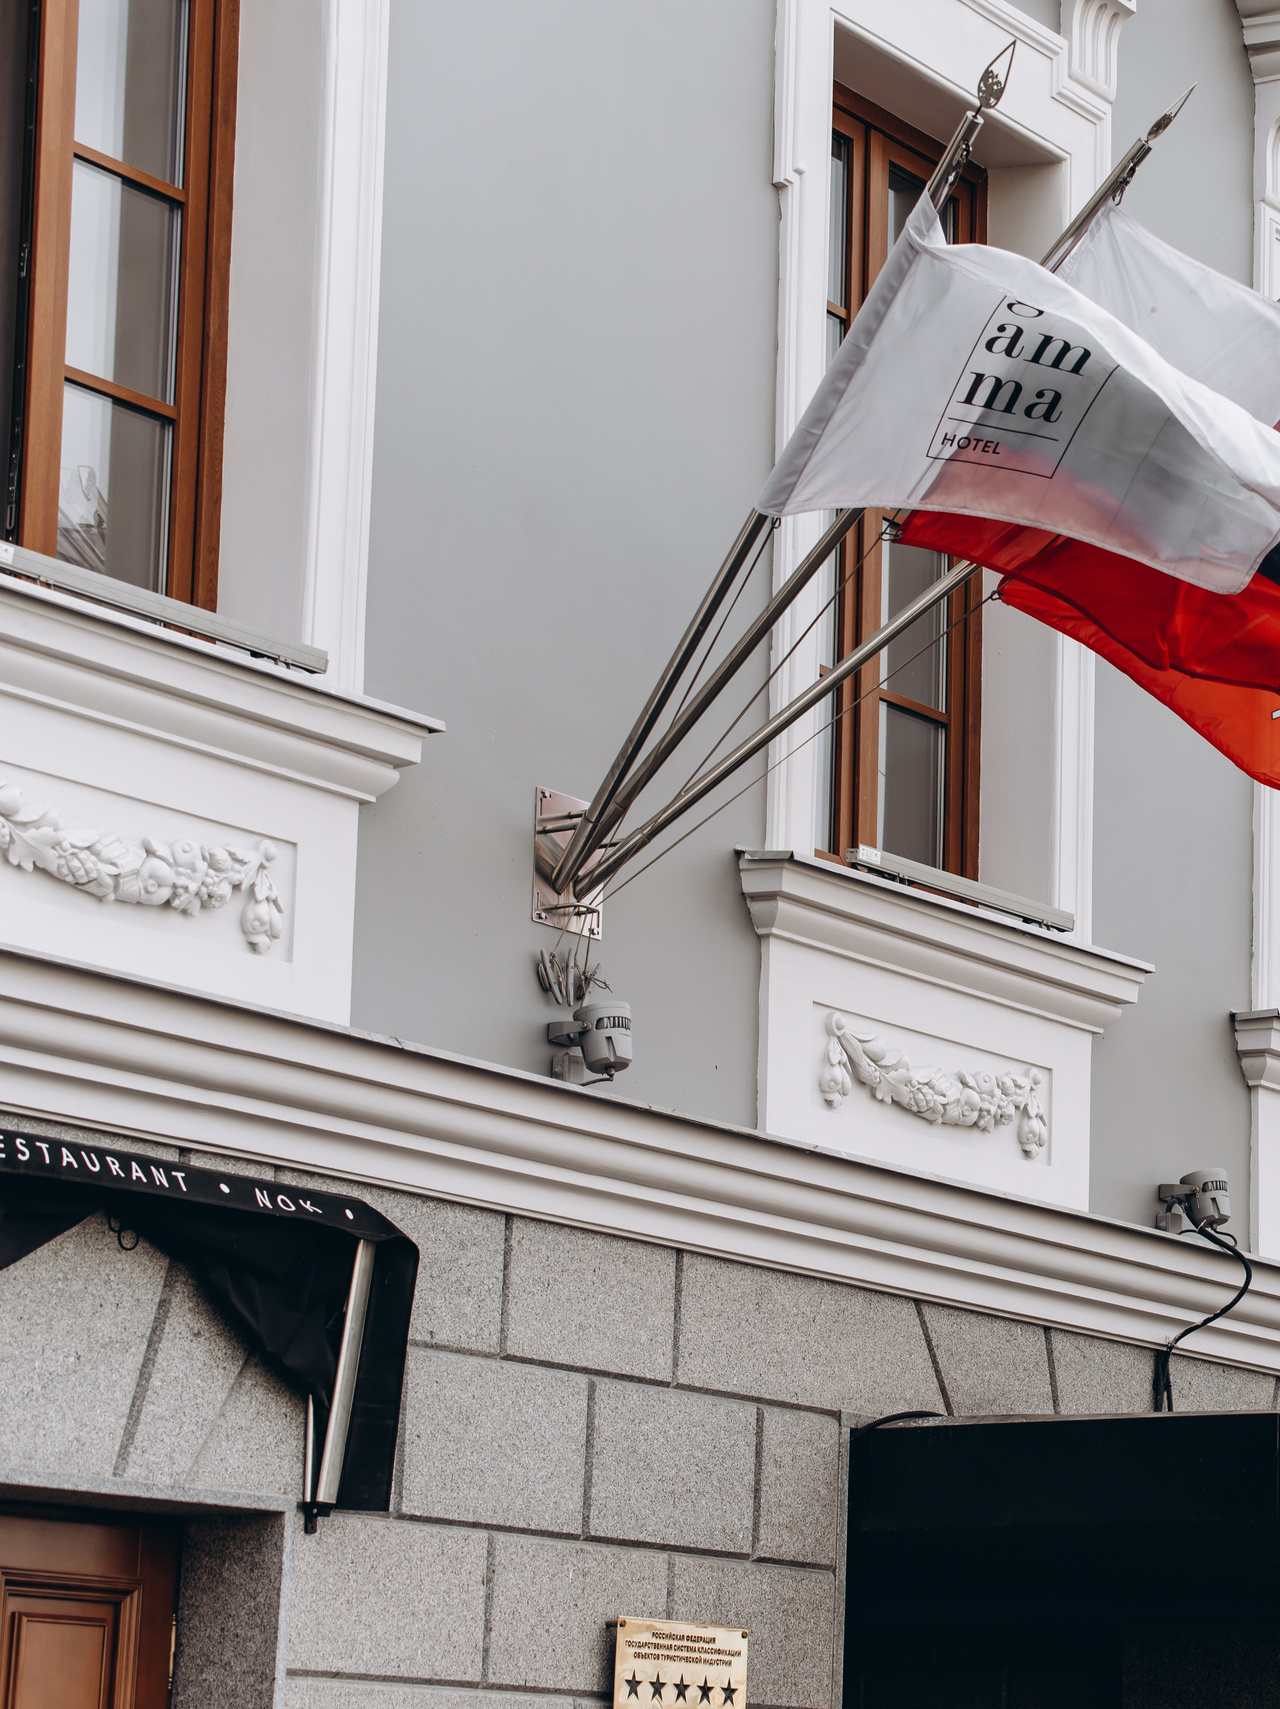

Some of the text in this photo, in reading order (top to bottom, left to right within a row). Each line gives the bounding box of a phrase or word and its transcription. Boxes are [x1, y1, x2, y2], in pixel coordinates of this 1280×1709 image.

[985, 323, 1092, 377] am
[956, 371, 1063, 423] ma
[941, 432, 1000, 455] HOTEL
[651, 1631, 717, 1645] РОССИЙСКАЯ ФЕДЕРАЦИЯ
[625, 1640, 742, 1658] ГОСУДАРСТВЕННАЯ СИСТЕМА КЛАССИФИКАЦИИ
[633, 1651, 733, 1667] ОБЪЕКТОВ ТУРИСТИЧЕСКОЙ ИНДУСТРИИ
